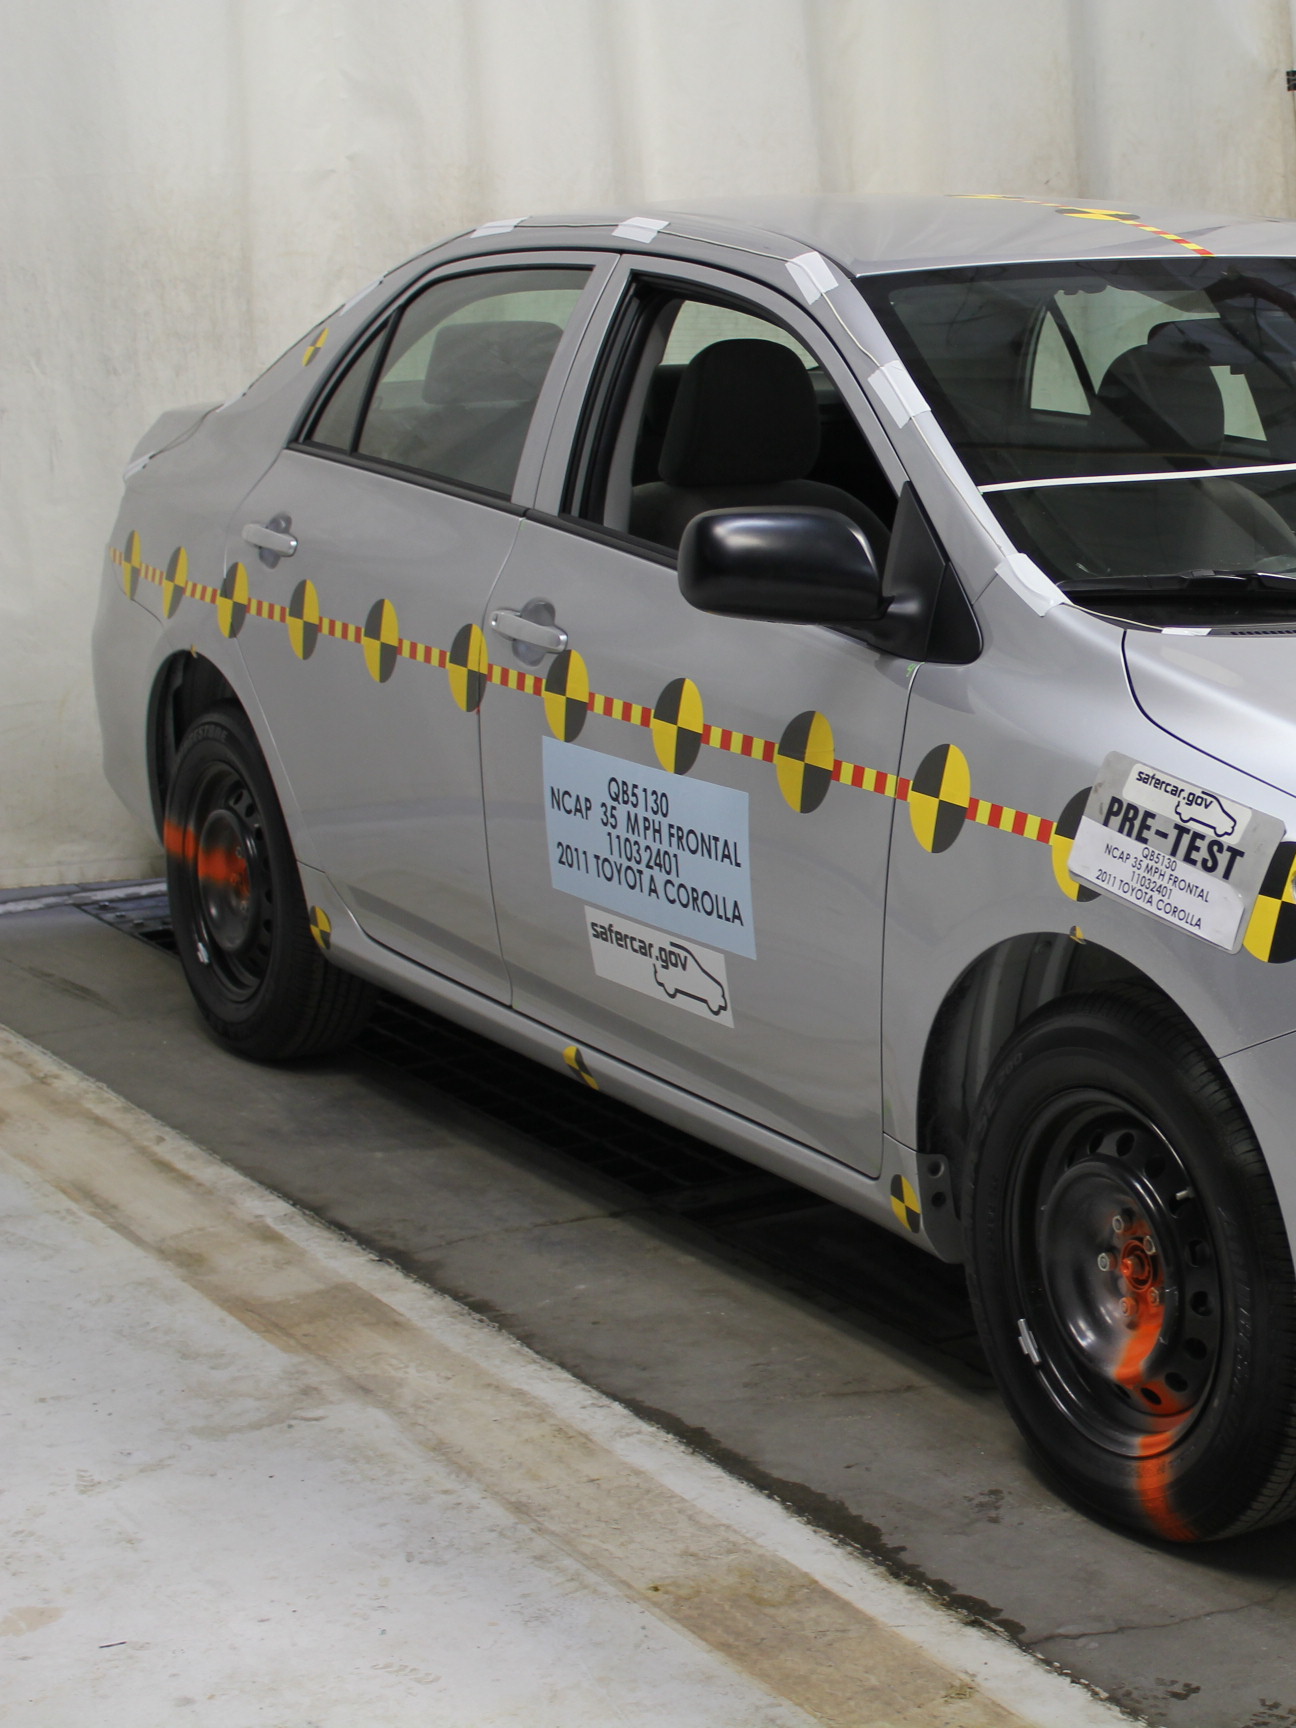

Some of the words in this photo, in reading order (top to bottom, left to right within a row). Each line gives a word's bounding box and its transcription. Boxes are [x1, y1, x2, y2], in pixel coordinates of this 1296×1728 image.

[608, 777, 669, 818] QB5130
[1136, 770, 1213, 810] safercar.gov
[550, 786, 592, 820] NCAP
[600, 802, 618, 829] 35
[626, 810, 662, 845] MPH
[668, 823, 741, 868] FRONTAL
[1103, 796, 1245, 881] PRE-TEST
[607, 832, 680, 878] 11032401
[1104, 843, 1131, 867] NCAP
[1131, 858, 1143, 871] 35
[1144, 863, 1166, 880] MPH
[1167, 874, 1210, 903] FRONTAL
[1141, 847, 1177, 872] QB5130
[557, 842, 589, 874] 2011
[594, 854, 659, 899] TOYOTA
[664, 879, 744, 926] COROLLA
[1096, 869, 1117, 888] 2011
[1118, 881, 1153, 907] TOYOTA
[1156, 899, 1202, 930] COROLLA
[1130, 871, 1173, 900] 11032401
[591, 921, 687, 971] safercar.gov
